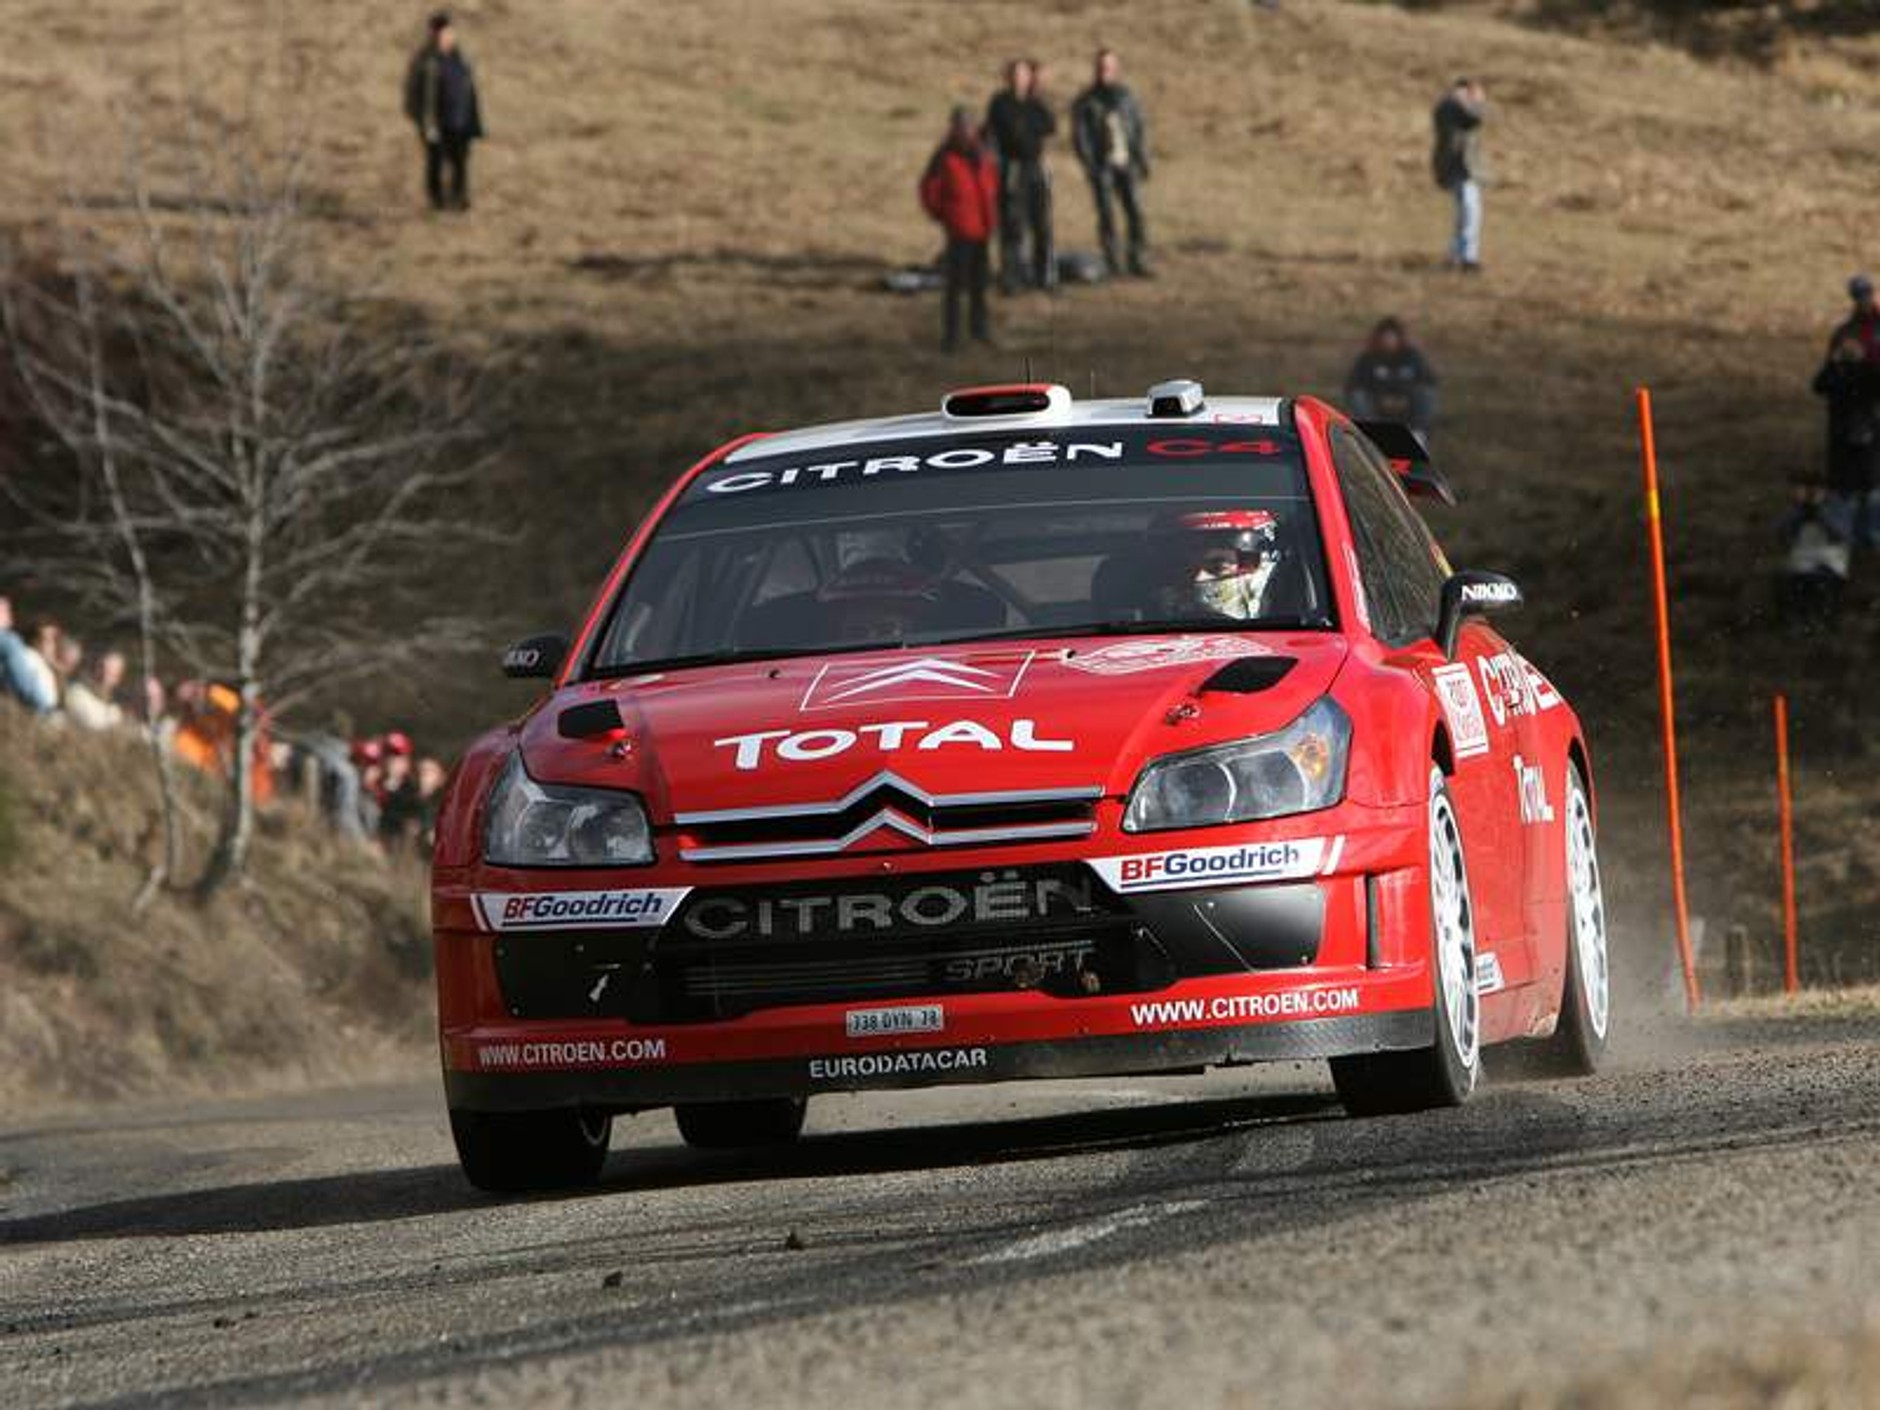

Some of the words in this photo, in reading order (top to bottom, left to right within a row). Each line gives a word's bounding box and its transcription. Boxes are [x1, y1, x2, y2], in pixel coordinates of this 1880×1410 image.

[706, 441, 1123, 494] CITROËN
[1147, 438, 1280, 456] C4
[714, 718, 1074, 770] TOTAL
[1120, 843, 1300, 882] BFGoodrich
[502, 892, 663, 921] BFGoodrich
[684, 869, 1093, 940] CITROËN
[1131, 986, 1360, 1026] WWW.CITROEN.COM
[479, 1038, 667, 1068] WWW.CITROEN.COM
[808, 1047, 988, 1080] EURODATACAR
